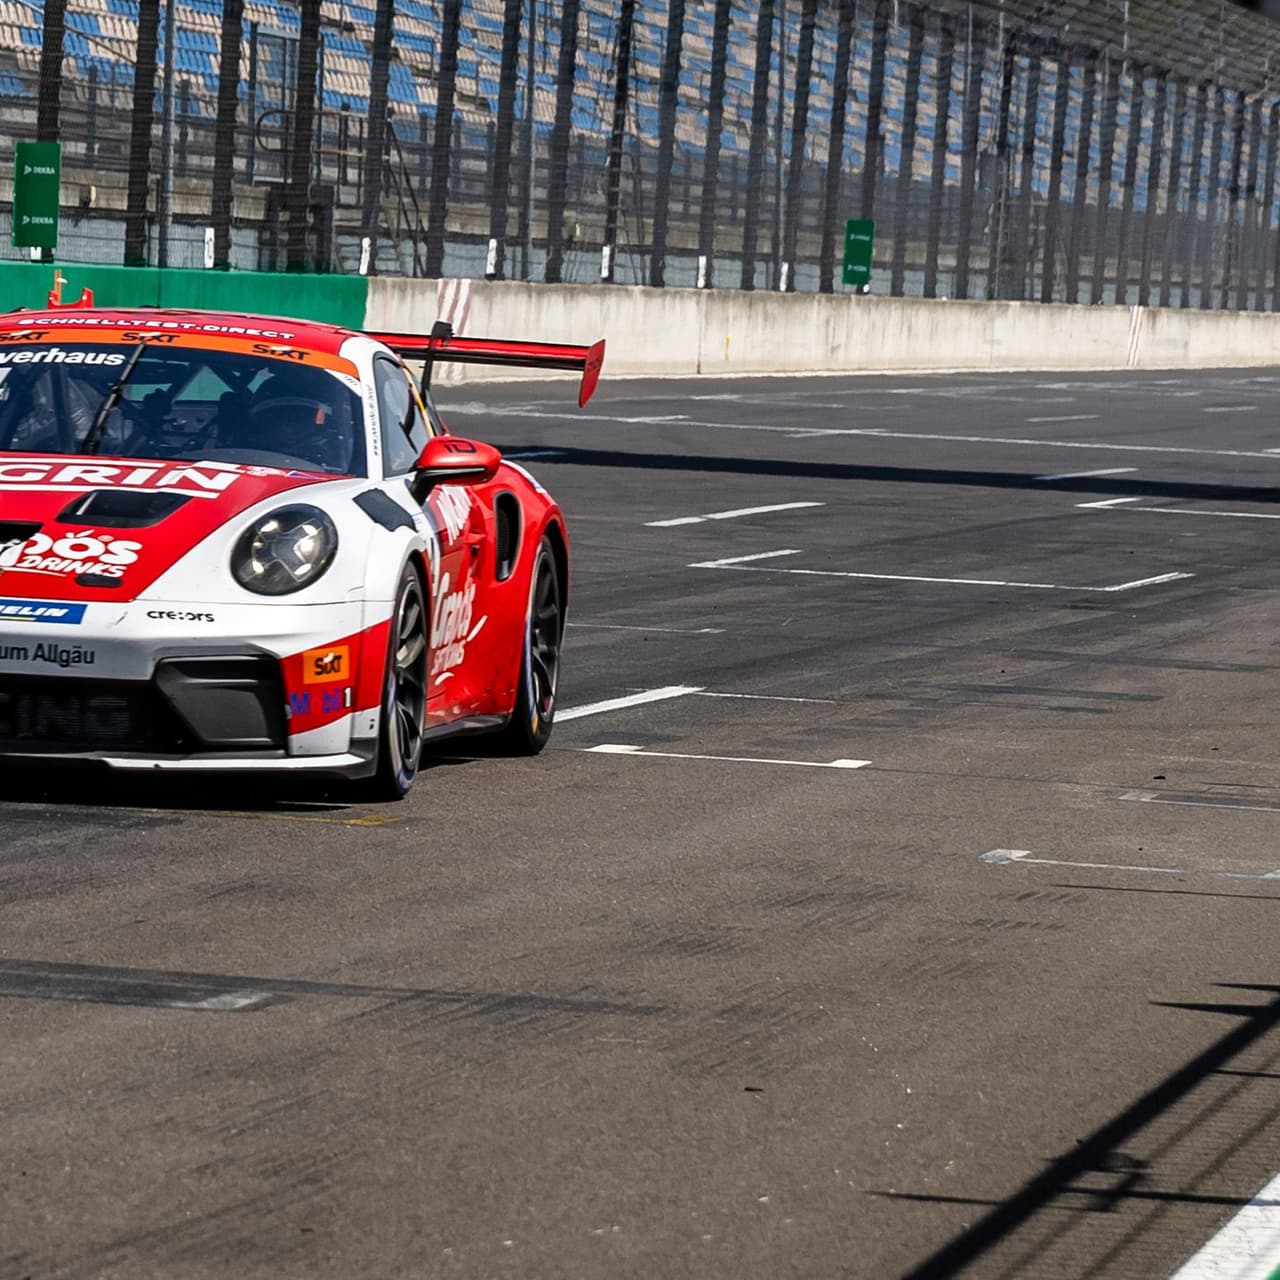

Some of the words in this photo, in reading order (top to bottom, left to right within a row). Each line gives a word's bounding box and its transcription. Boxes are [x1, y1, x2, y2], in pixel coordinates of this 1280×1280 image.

[16, 318, 296, 340] SCHNELLTEST.DIRECT
[16, 555, 127, 577] DRINKS
[32, 642, 96, 668] Allgäu
[344, 686, 352, 708] 1
